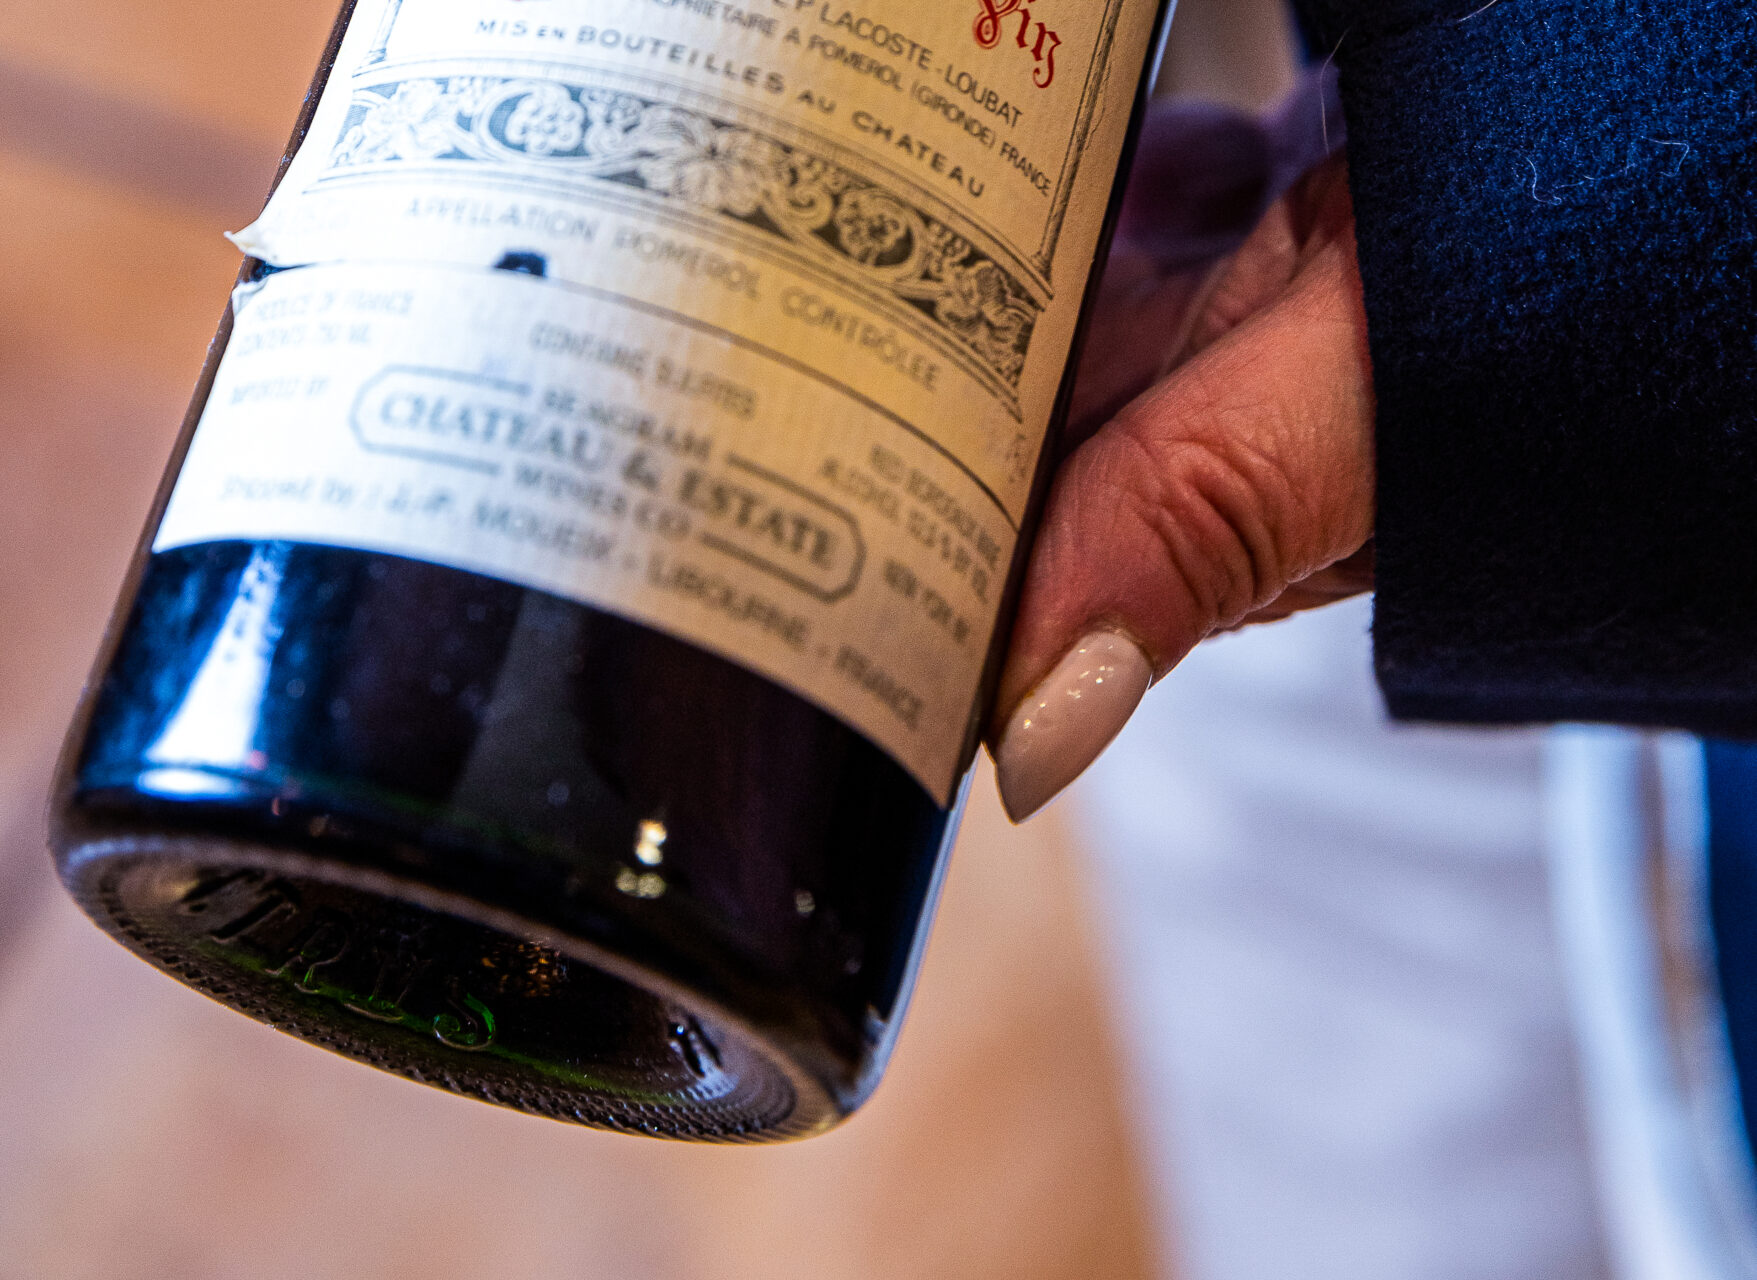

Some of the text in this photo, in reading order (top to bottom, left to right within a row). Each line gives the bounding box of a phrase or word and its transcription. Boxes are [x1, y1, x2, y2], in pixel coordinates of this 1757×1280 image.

[475, 19, 528, 37] MIS
[577, 25, 786, 94] BOUTEILLES
[797, 88, 837, 114] AU
[851, 109, 986, 198] CHATEAU
[807, 33, 903, 92] POMEROL
[910, 78, 996, 150] (GIRONDE)
[1000, 140, 1052, 198] FRANCE
[406, 196, 601, 243] APPELLATION
[613, 224, 762, 301] POMEROL
[379, 390, 842, 572] CHATEAU & ESTATE
